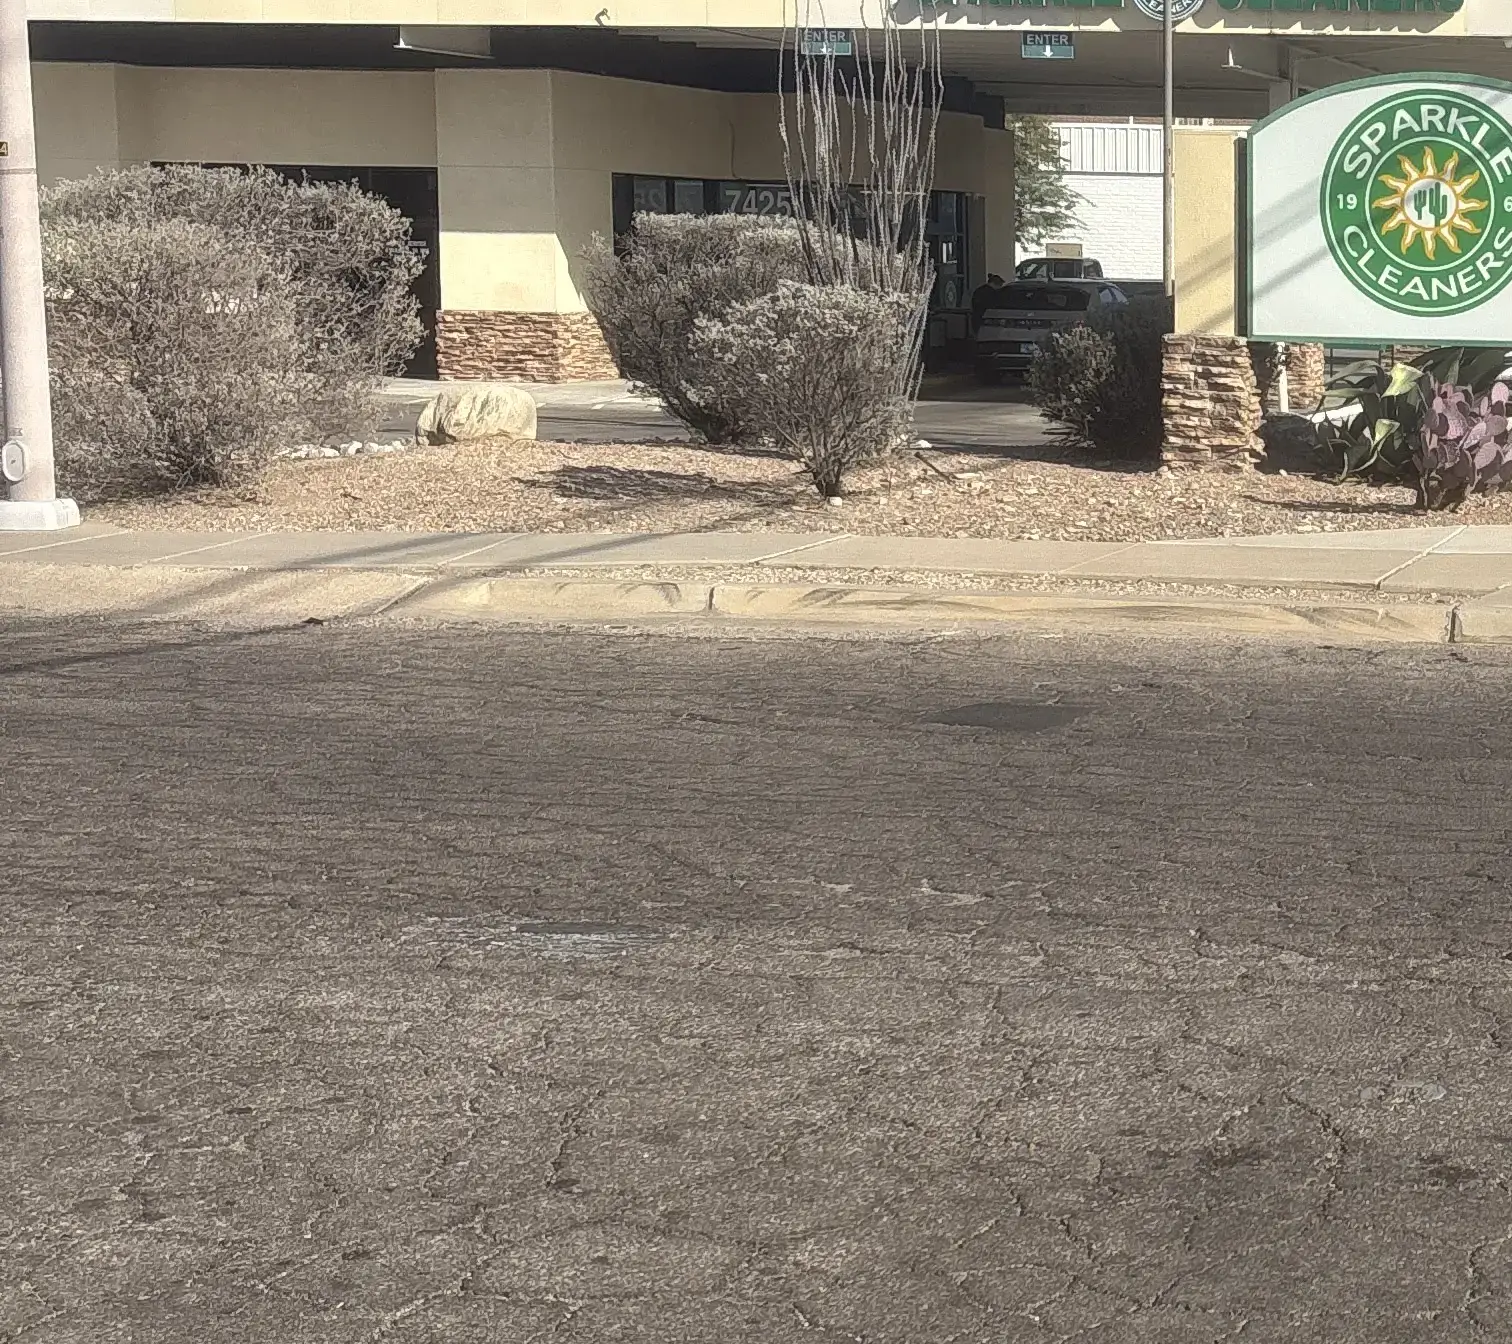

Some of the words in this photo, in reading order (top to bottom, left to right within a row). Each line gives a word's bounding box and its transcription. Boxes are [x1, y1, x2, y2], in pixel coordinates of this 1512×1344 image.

[1026, 34, 1069, 45] ENTER
[725, 189, 792, 217] 7425
[1336, 193, 1358, 210] 19
